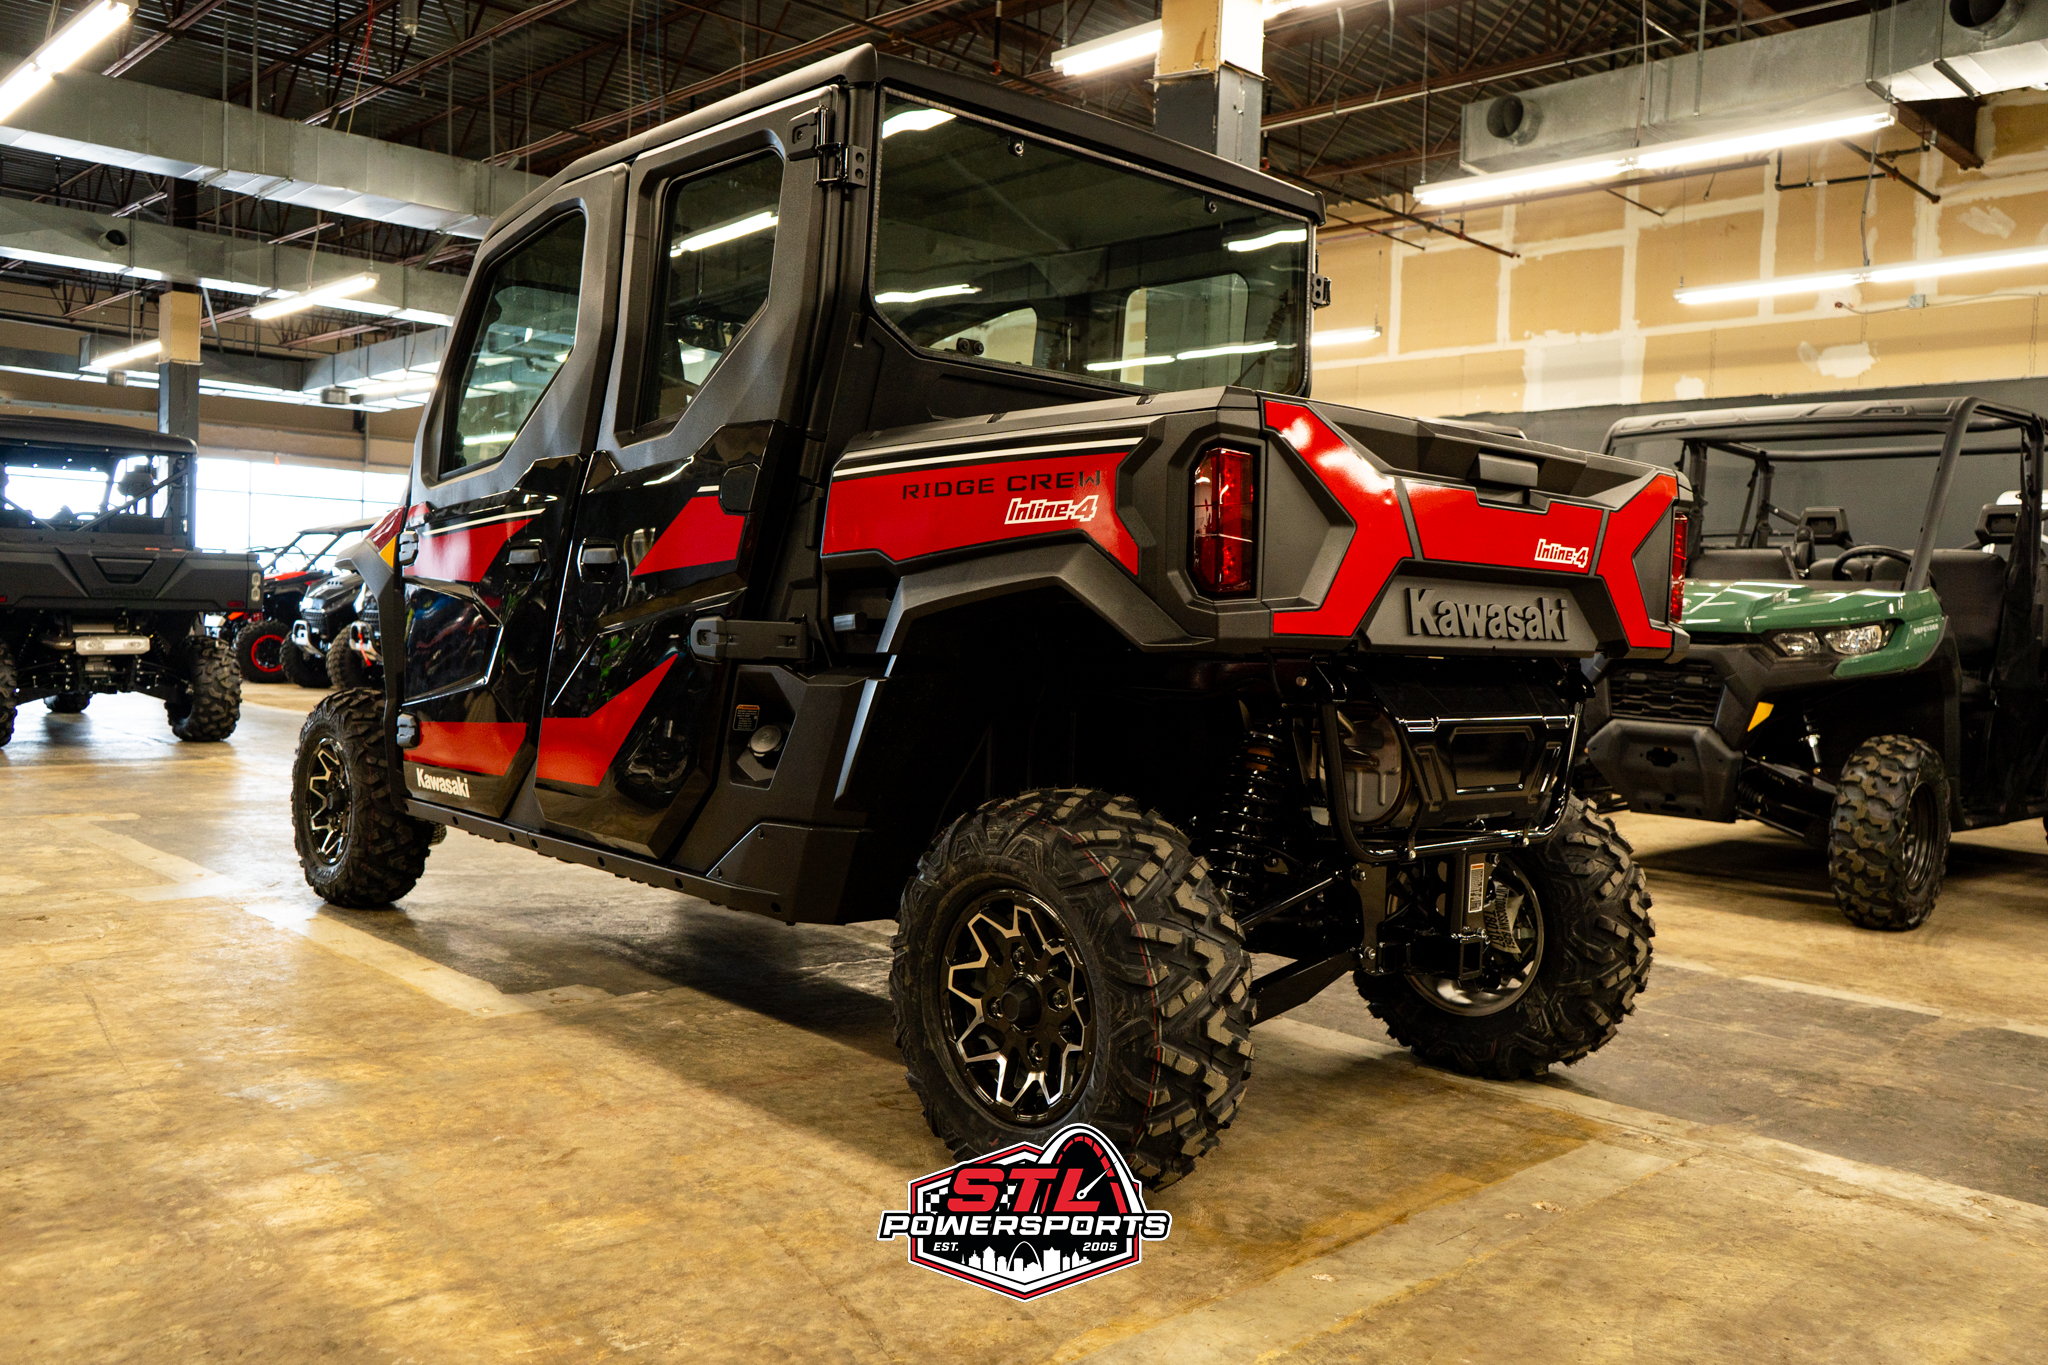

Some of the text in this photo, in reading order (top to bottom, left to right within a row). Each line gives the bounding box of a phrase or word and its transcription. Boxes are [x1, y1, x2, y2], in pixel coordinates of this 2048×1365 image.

[902, 470, 1101, 500] RIDGE CREW
[1406, 587, 1570, 641] Kawasaki
[416, 767, 471, 799] Kawasaki
